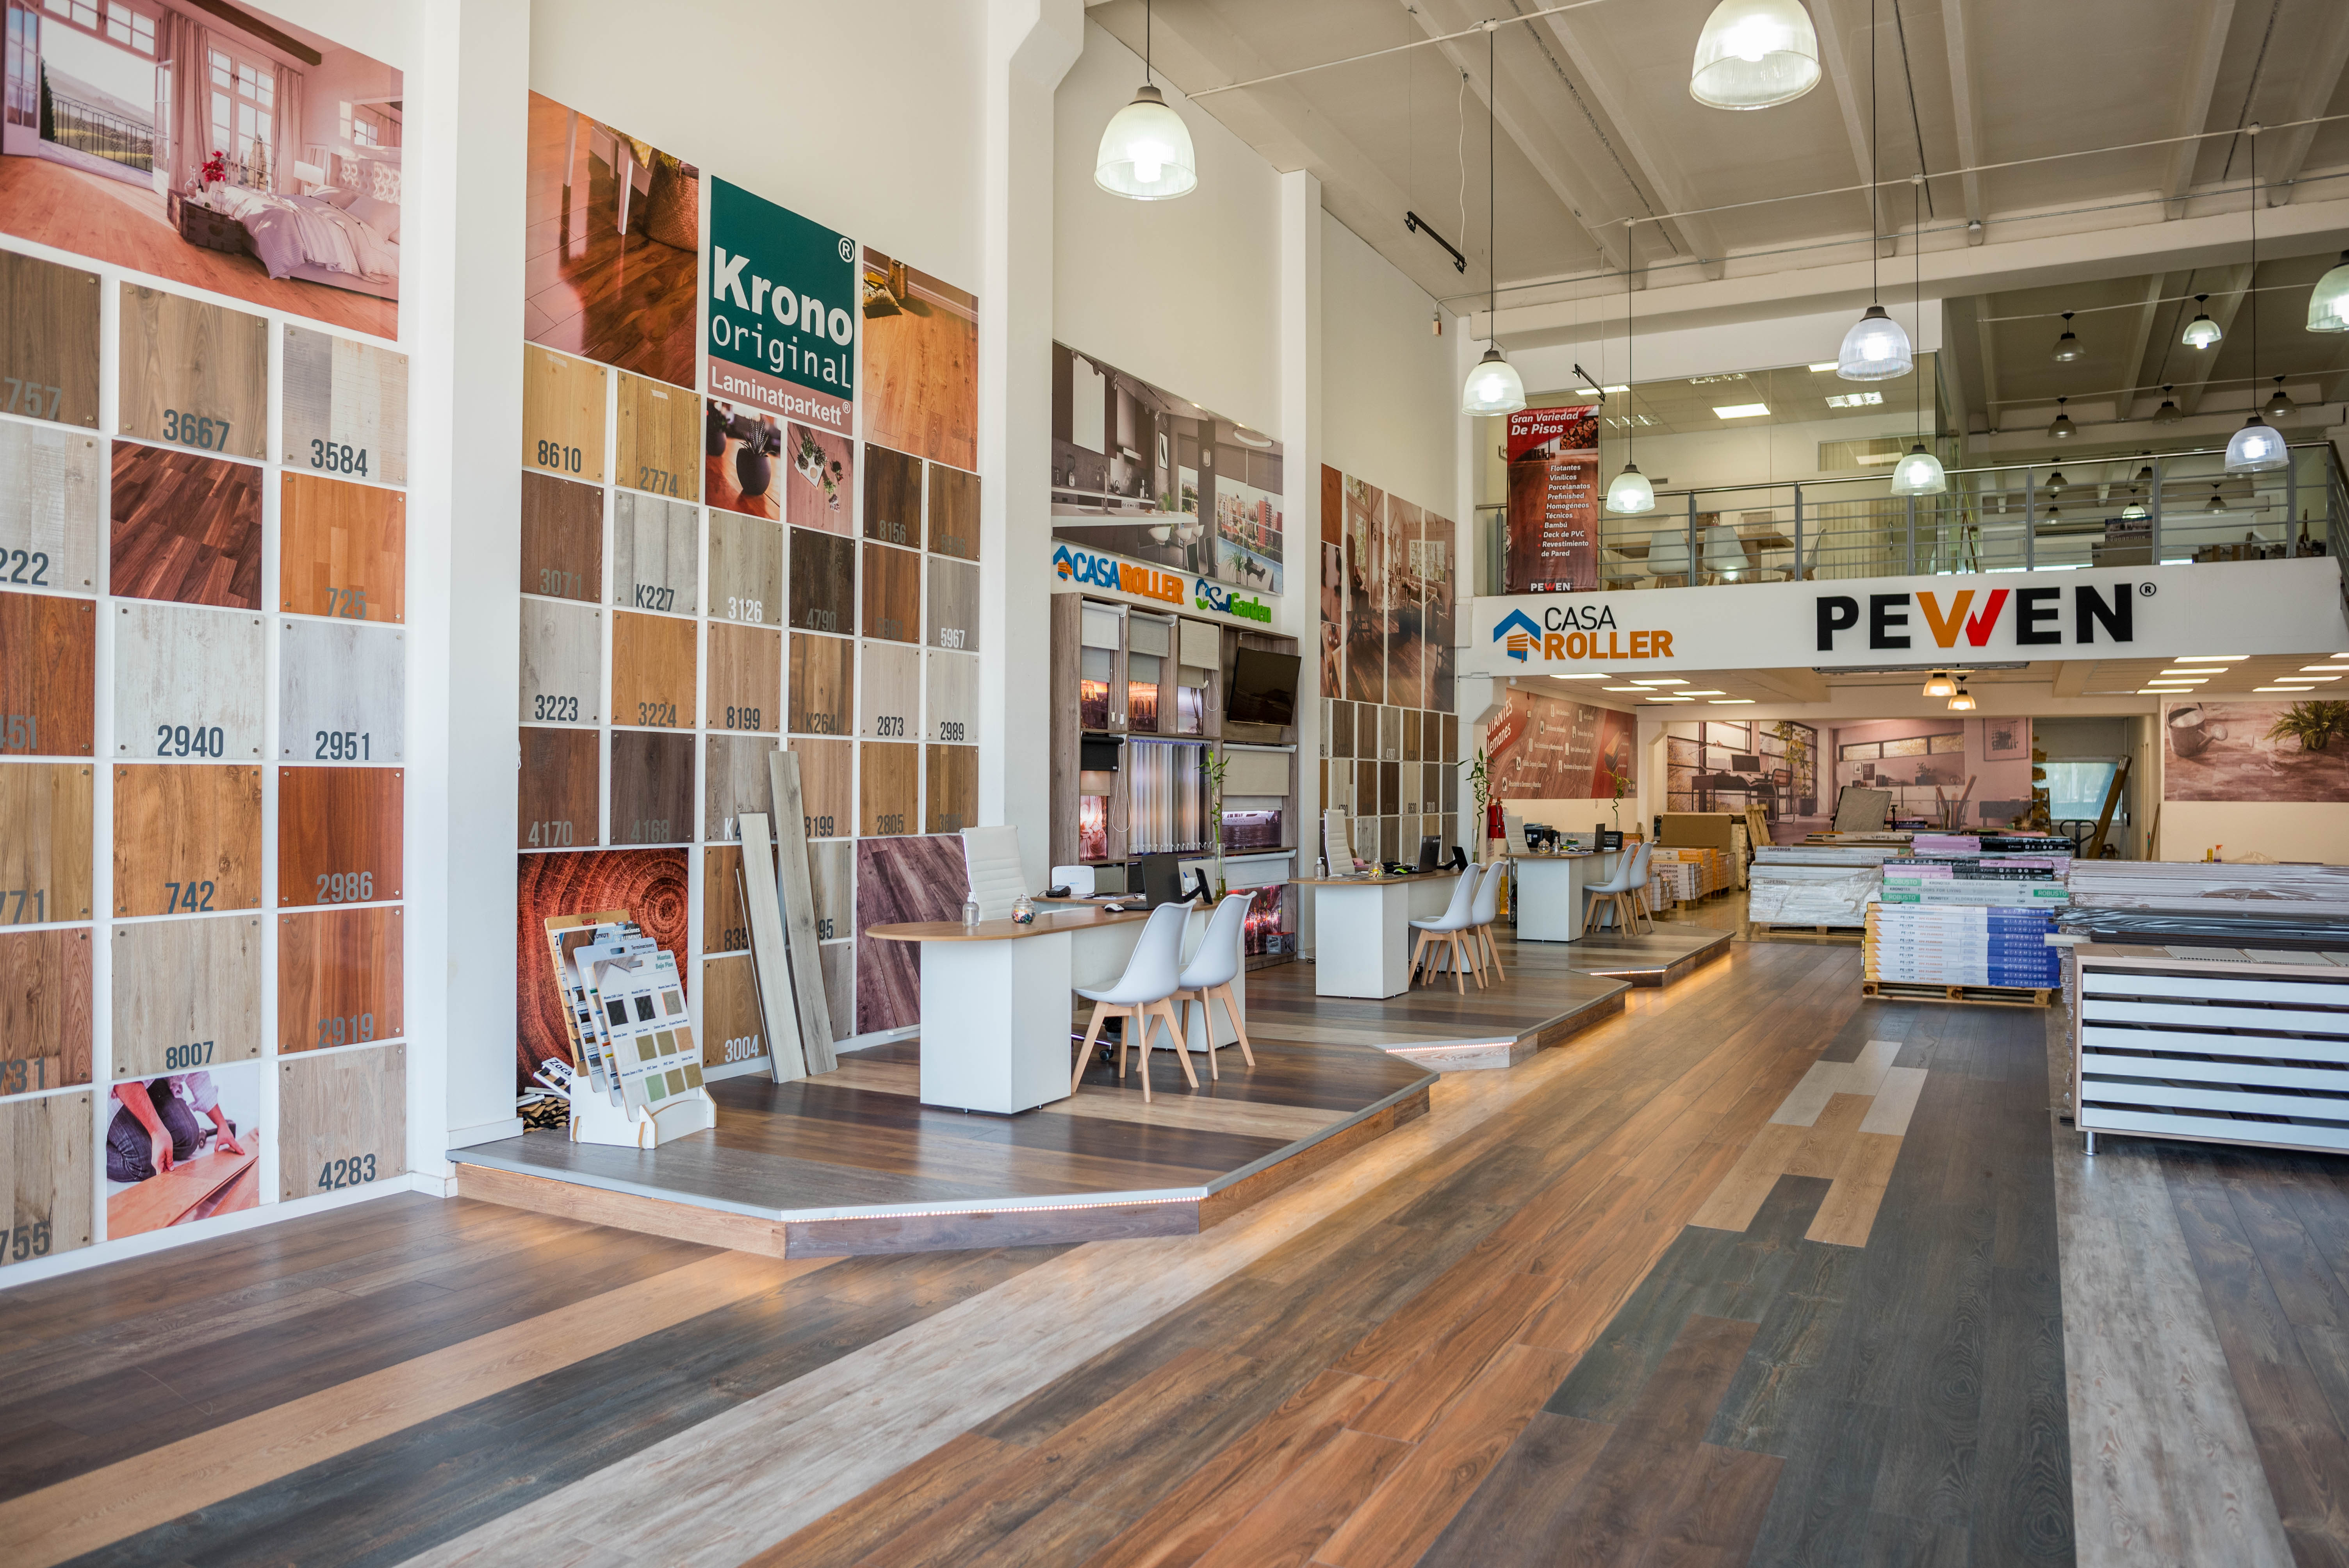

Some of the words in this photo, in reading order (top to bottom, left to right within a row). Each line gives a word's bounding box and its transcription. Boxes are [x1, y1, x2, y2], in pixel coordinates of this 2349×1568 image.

[714, 245, 853, 346] Krono
[713, 315, 851, 389] Original
[0, 377, 62, 419] 757
[163, 409, 230, 451] 3667
[1511, 414, 1533, 423] Gran
[1536, 411, 1579, 422] Variedad
[1511, 425, 1528, 436] De
[1531, 423, 1563, 434] Pisos
[310, 439, 368, 477] 3584
[538, 440, 581, 472] 8610
[640, 466, 678, 497] 2774
[1546, 502, 1589, 510] Homogéneos
[879, 520, 906, 544] 8156
[540, 568, 582, 598] 3071
[1530, 582, 1570, 592] PEWEN
[325, 587, 367, 620] 725
[636, 584, 674, 612] K227
[728, 597, 762, 623] 3126
[806, 608, 836, 633] 4790
[877, 617, 903, 640] 5963
[1545, 605, 1617, 631] CASA
[941, 628, 965, 649] 5967
[1544, 630, 1674, 660] ROLLER
[535, 694, 578, 722] 3223
[638, 702, 676, 727] 3224
[727, 706, 760, 730] 8199
[806, 713, 836, 734] K264
[877, 716, 904, 736] 2873
[940, 722, 964, 741] 2989
[157, 725, 224, 758] 2940
[315, 731, 370, 761] 2951
[1487, 722, 1511, 757] lemanes
[1386, 748, 1395, 759] 4797
[1408, 802, 1417, 813] 8630
[1427, 802, 1435, 813] 3010
[528, 820, 573, 847] 4170
[631, 819, 670, 843] 4168
[877, 814, 904, 834] 2805
[165, 880, 214, 914] 742
[317, 871, 373, 903] 2986
[613, 927, 640, 935] Terminaciones
[317, 1013, 374, 1049] 2919
[166, 1041, 214, 1070] 8007
[725, 1035, 759, 1062] 3004
[318, 1153, 376, 1191] 4283
